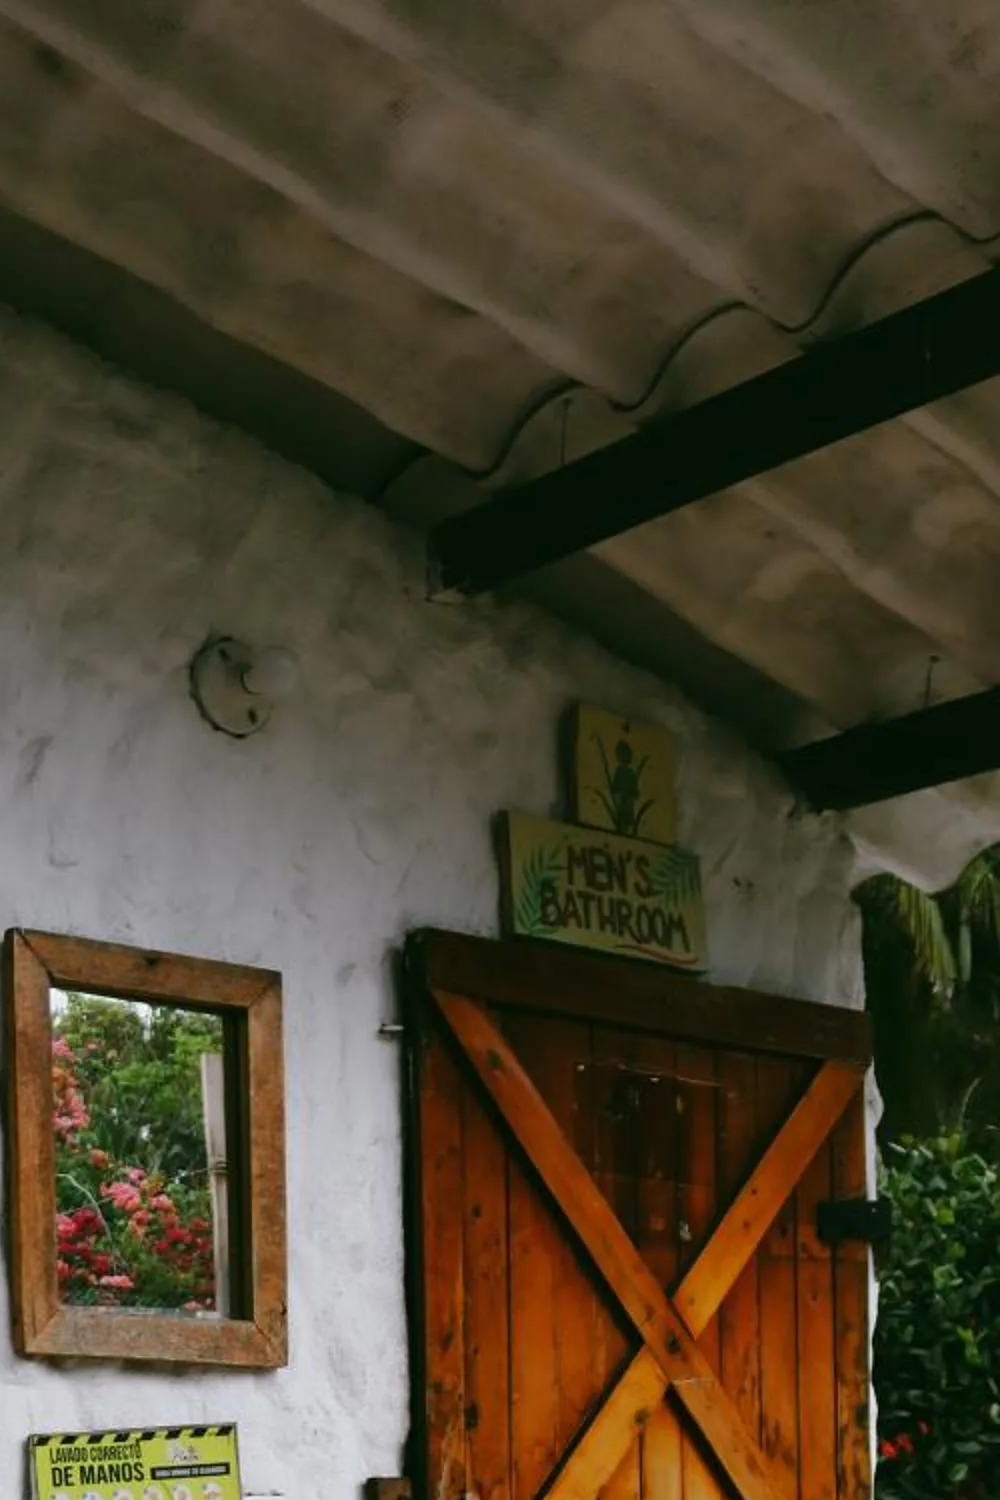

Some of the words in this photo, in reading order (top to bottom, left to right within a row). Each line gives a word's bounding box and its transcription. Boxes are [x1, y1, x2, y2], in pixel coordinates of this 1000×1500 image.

[566, 844, 653, 898] MEN'S
[540, 875, 690, 953] BATHROOM
[52, 1465, 75, 1487] DE
[80, 1462, 145, 1485] MANOS
